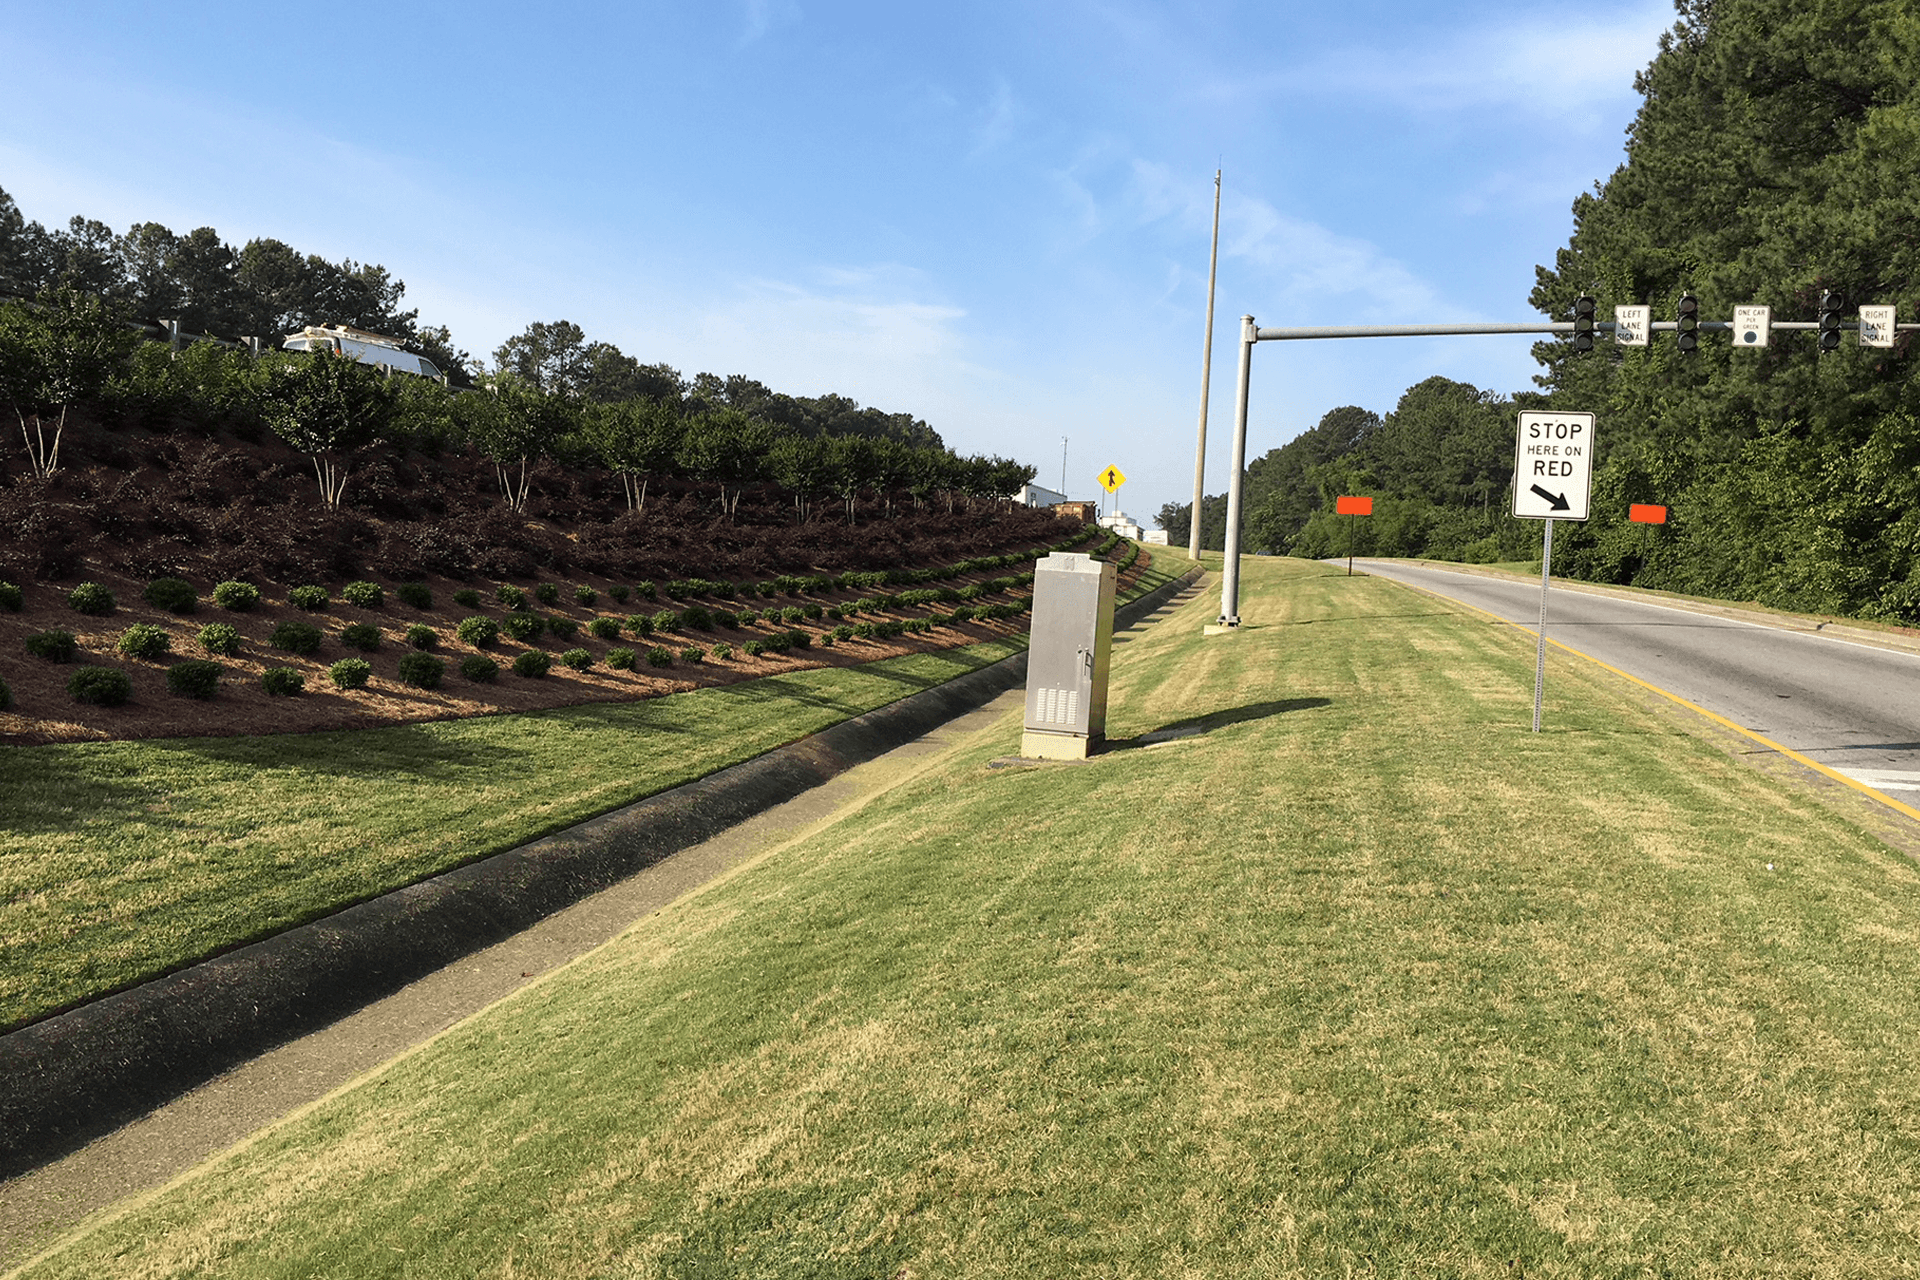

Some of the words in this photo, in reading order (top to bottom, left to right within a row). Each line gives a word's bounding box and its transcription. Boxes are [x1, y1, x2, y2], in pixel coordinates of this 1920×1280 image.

[1622, 310, 1642, 318] LEFT
[1865, 310, 1888, 319] RIGHT
[1621, 322, 1641, 330] LANE
[1866, 322, 1887, 331] LANE
[1617, 333, 1645, 342] SIGNAL
[1861, 333, 1890, 343] SIGNAL
[1529, 422, 1582, 440] STOP
[1527, 444, 1559, 456] HERE
[1564, 445, 1582, 456] ON
[1533, 460, 1573, 477] RED
